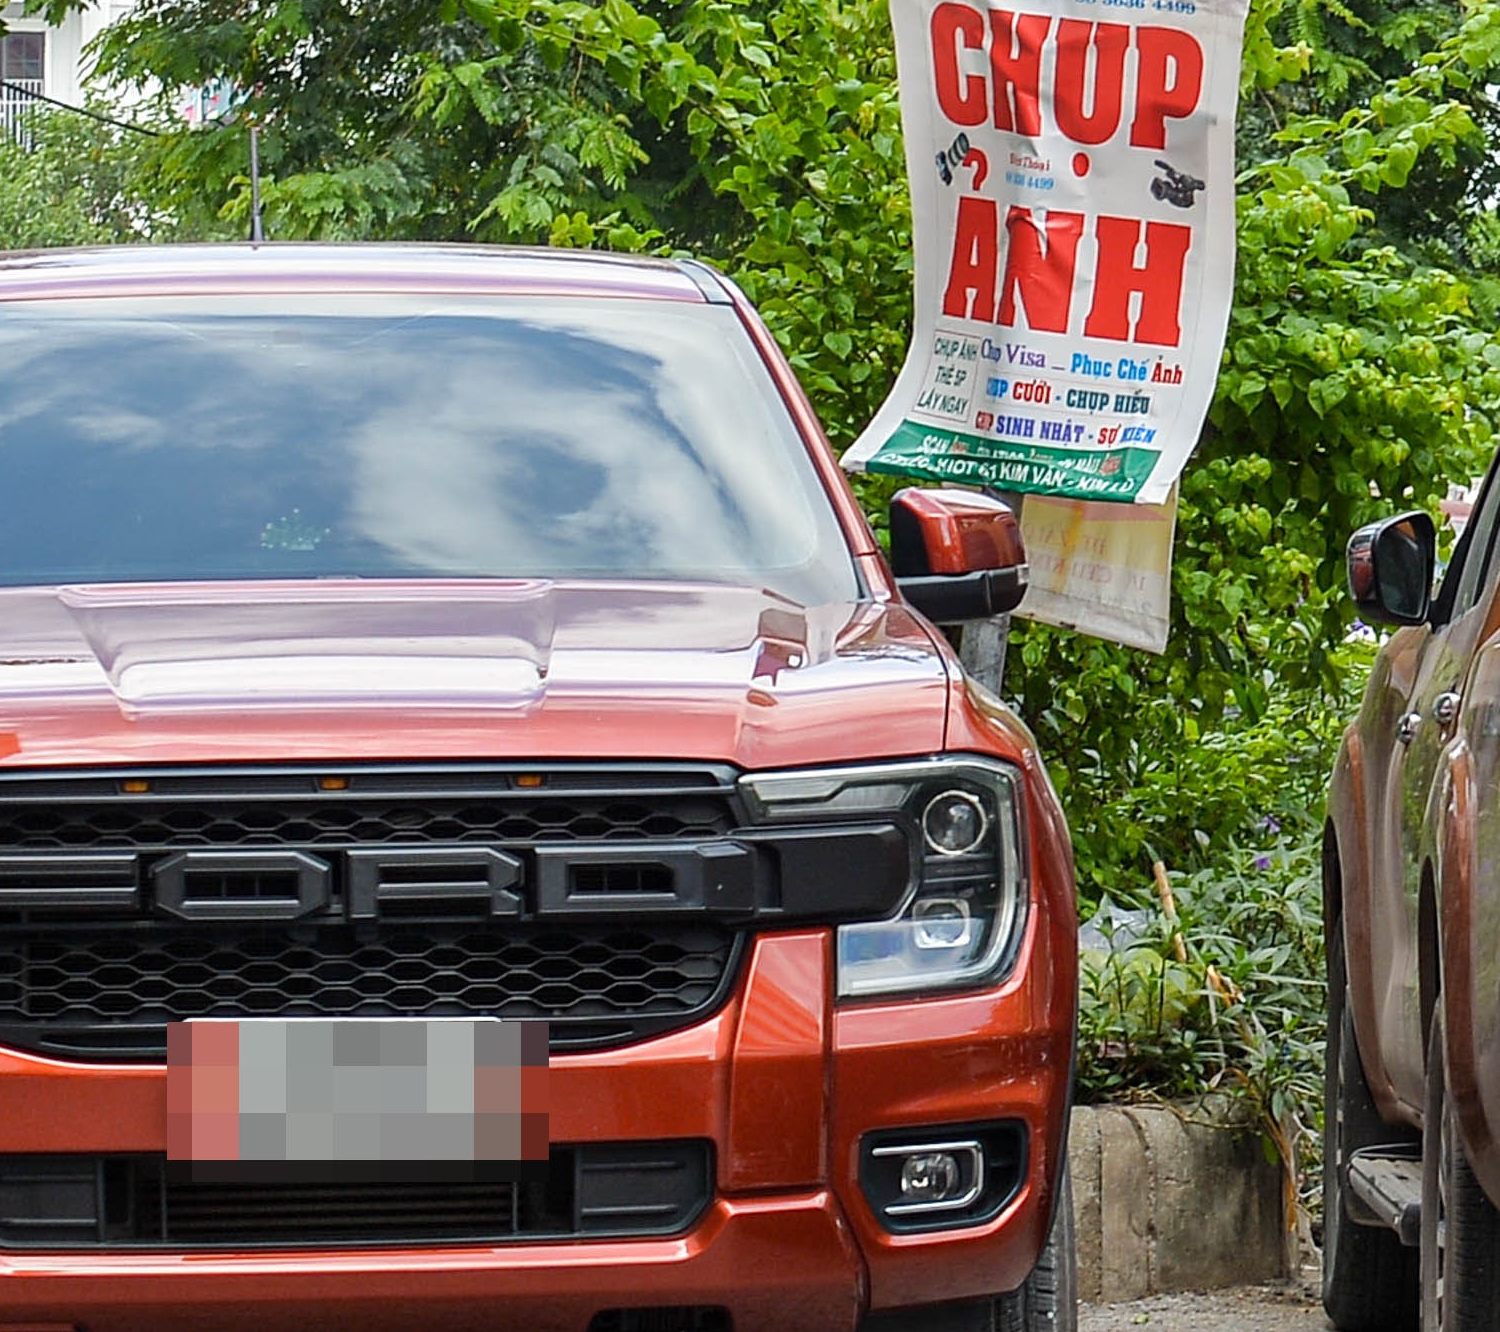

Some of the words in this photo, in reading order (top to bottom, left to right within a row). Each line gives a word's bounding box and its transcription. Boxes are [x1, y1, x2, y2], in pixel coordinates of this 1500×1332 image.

[930, 1, 1204, 177] CHỤP
[942, 147, 1192, 348] ẢNH
[1006, 343, 1046, 368] Visa
[1071, 353, 1112, 380] Phục
[1117, 358, 1150, 381] Chế
[1151, 355, 1183, 384] Ảnh
[1066, 389, 1110, 415] CHỤP
[996, 415, 1035, 438] SINH
[1040, 418, 1085, 446] NHẬT
[999, 462, 1030, 483] KIM
